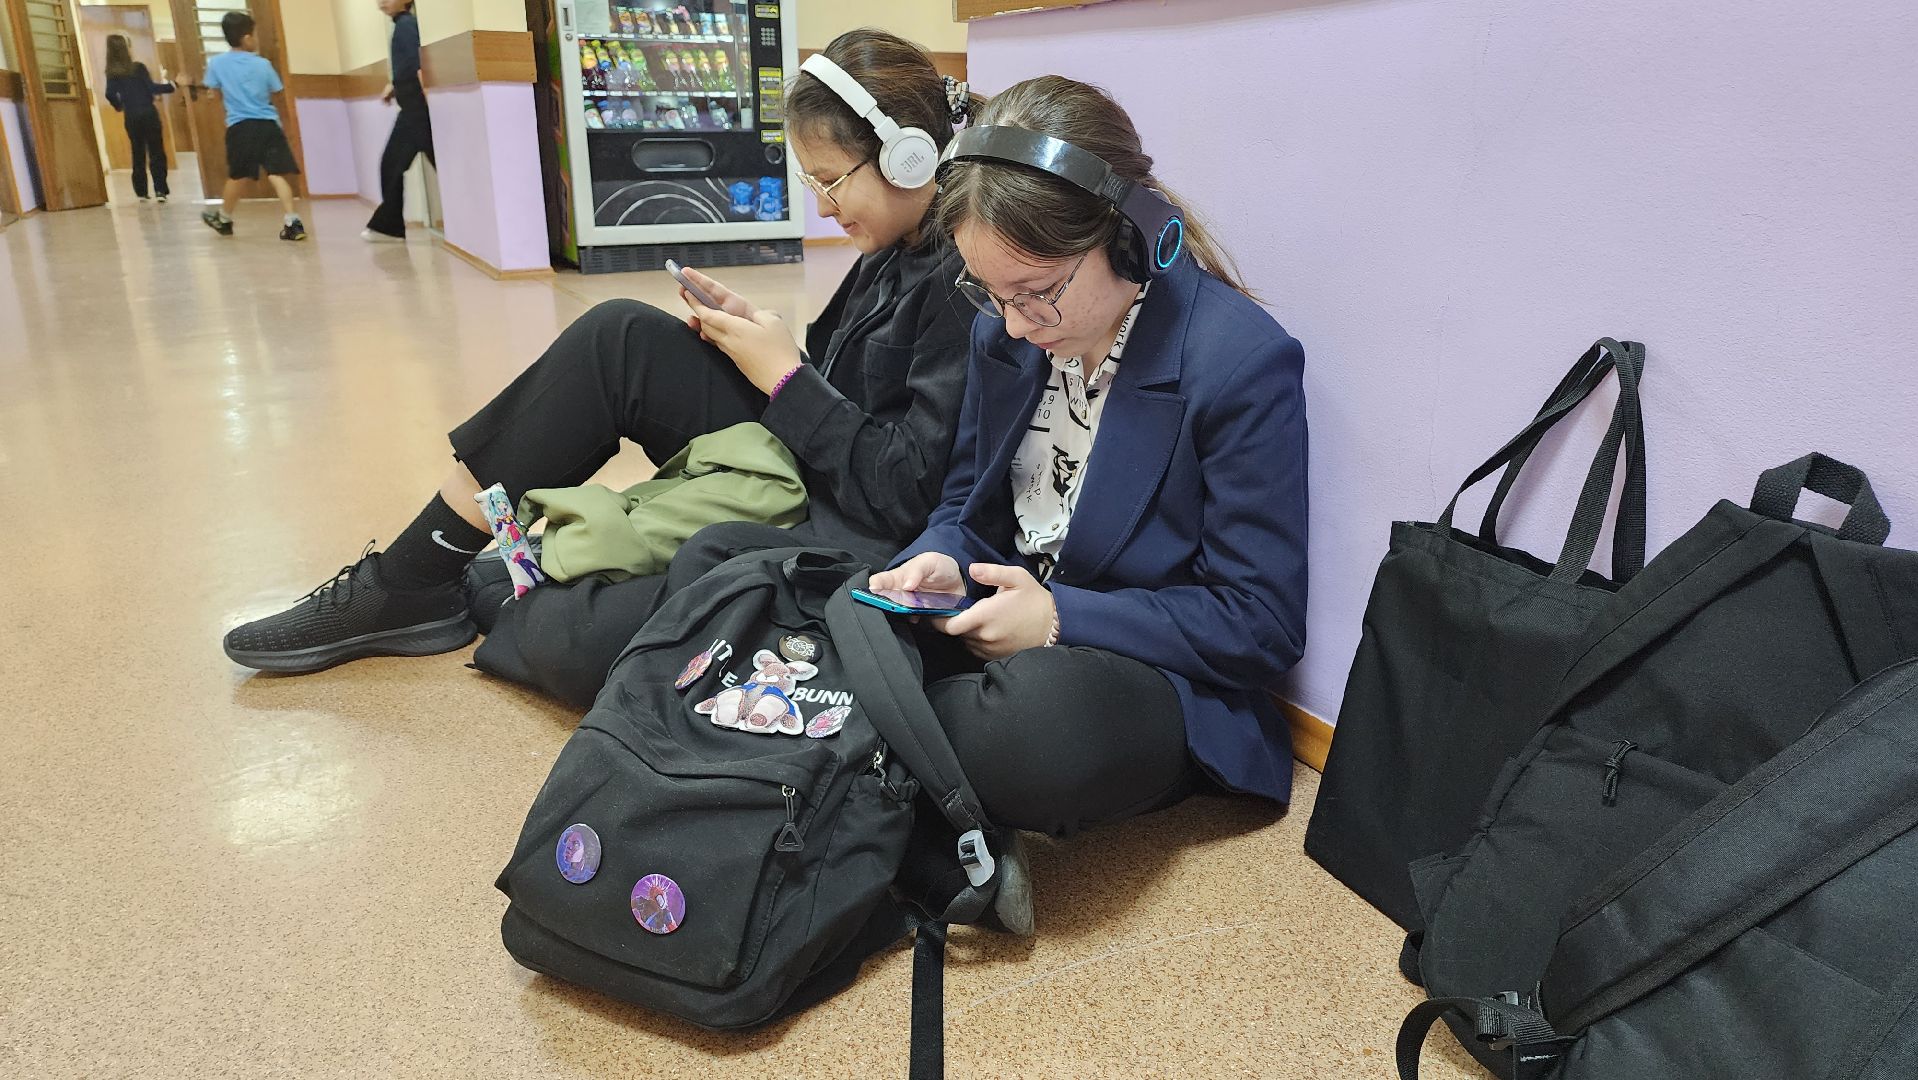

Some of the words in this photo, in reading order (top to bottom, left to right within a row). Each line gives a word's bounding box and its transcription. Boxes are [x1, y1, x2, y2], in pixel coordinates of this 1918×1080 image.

[899, 151, 925, 174] JBL
[1114, 313, 1132, 349] work
[790, 686, 854, 706] BUNN
